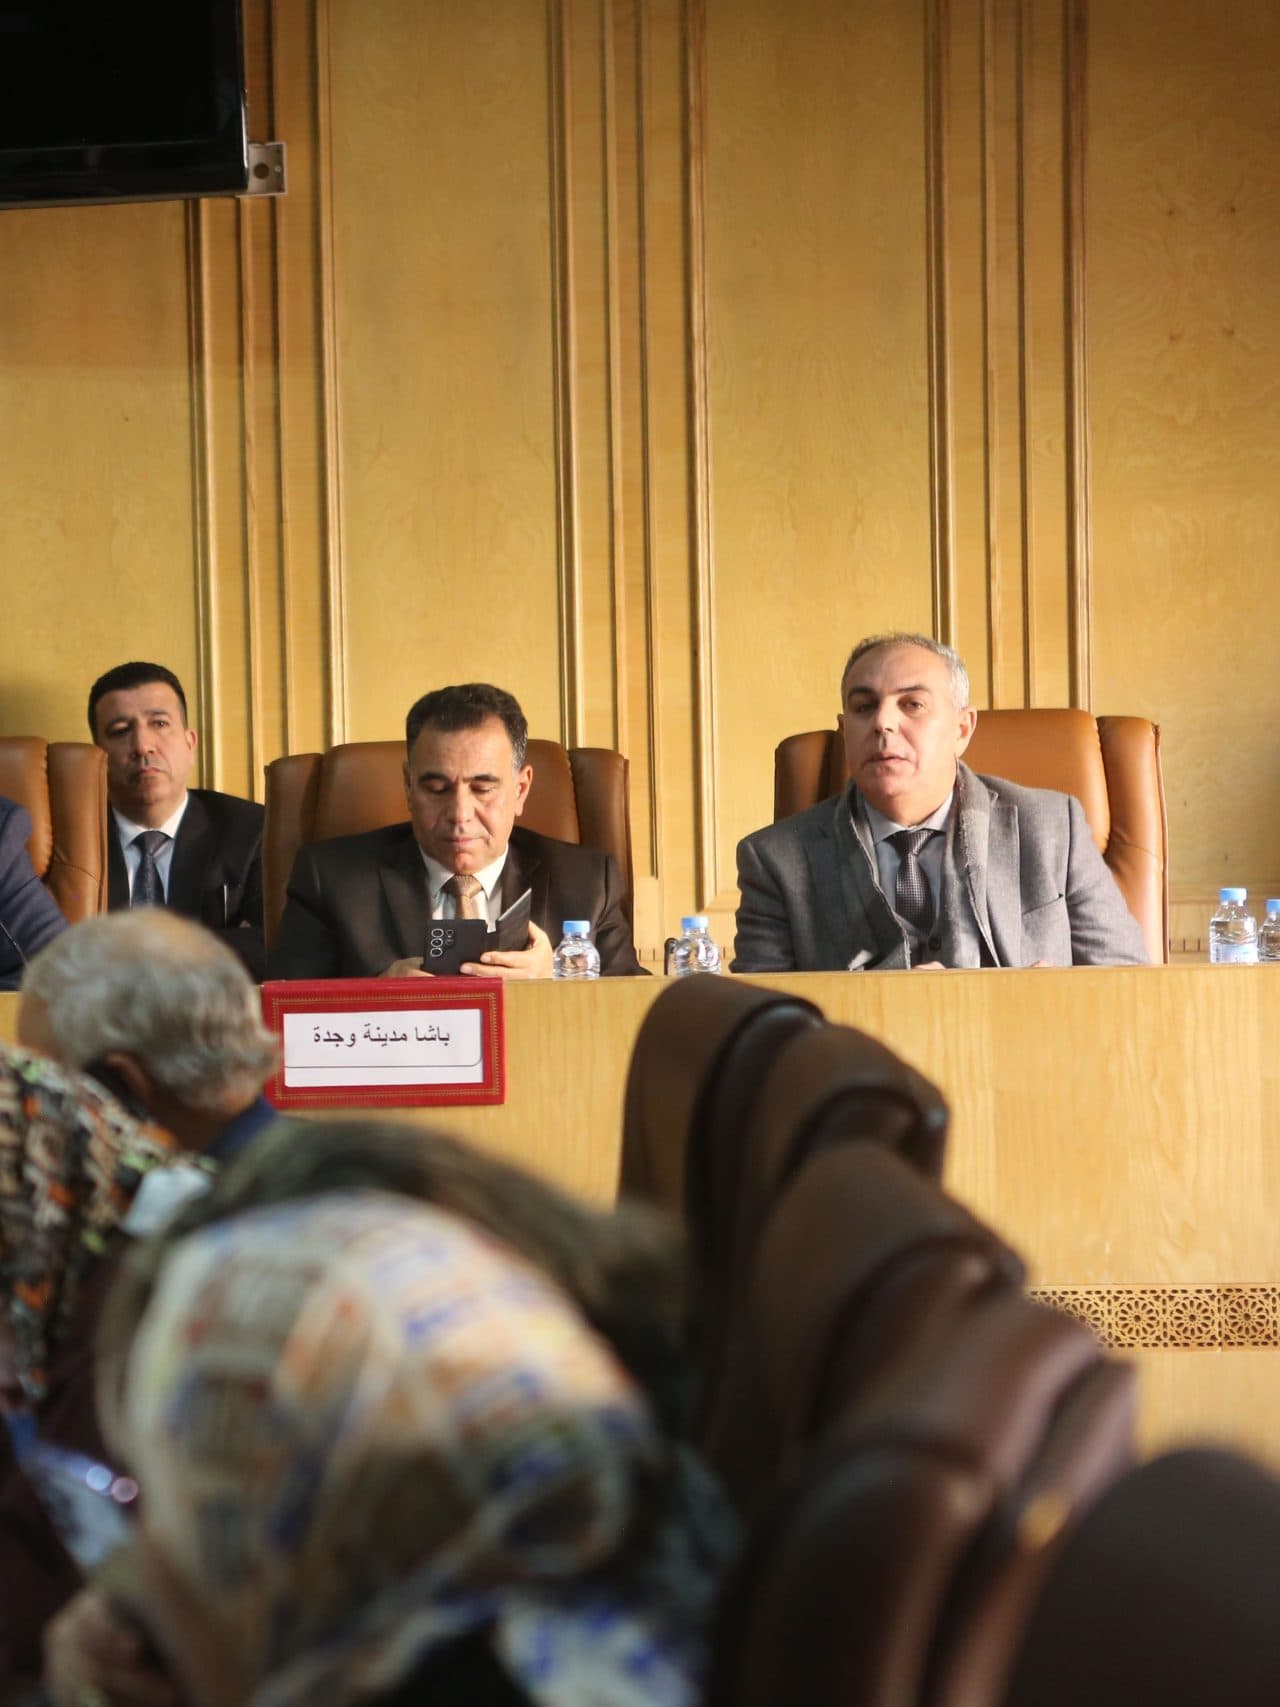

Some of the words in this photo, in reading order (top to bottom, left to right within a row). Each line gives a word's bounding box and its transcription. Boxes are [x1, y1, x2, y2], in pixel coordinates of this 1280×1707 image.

[312, 1025, 357, 1048] وجدة
[362, 1022, 408, 1048] مدينة
[414, 1024, 451, 1047] باشا
